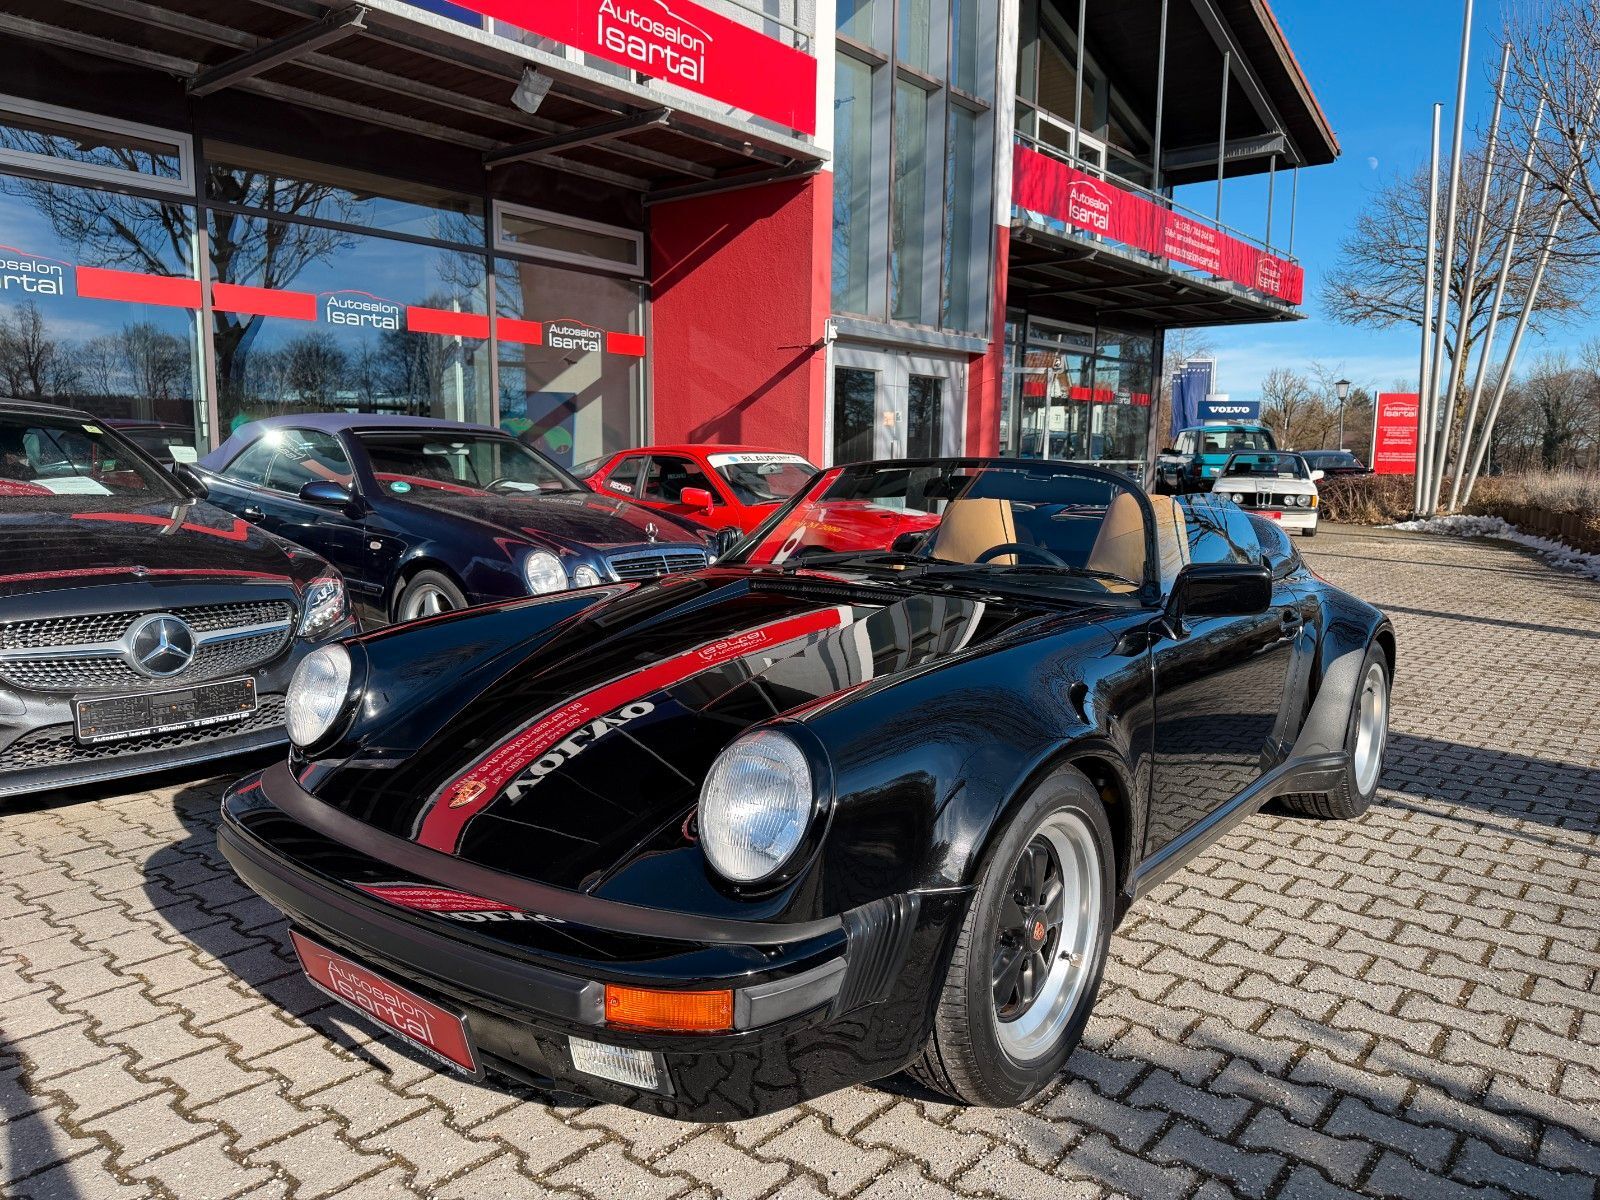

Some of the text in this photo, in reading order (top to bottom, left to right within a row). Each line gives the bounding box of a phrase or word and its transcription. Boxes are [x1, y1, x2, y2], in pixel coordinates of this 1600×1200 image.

[599, 0, 704, 54] Autosalon
[598, 14, 704, 84] Isartal
[1069, 188, 1109, 212] Autosalon
[1069, 198, 1109, 230] Isartal
[0, 273, 64, 296] rtal
[327, 296, 399, 314] Autosalon
[327, 306, 399, 330] Isartal
[549, 324, 601, 339] Autosalon
[549, 333, 601, 352] Isartal
[610, 481, 632, 493] RECARO
[92, 733, 127, 743] Autosalon
[328, 960, 427, 1024] Autosalon
[329, 970, 434, 1045] Isartal
